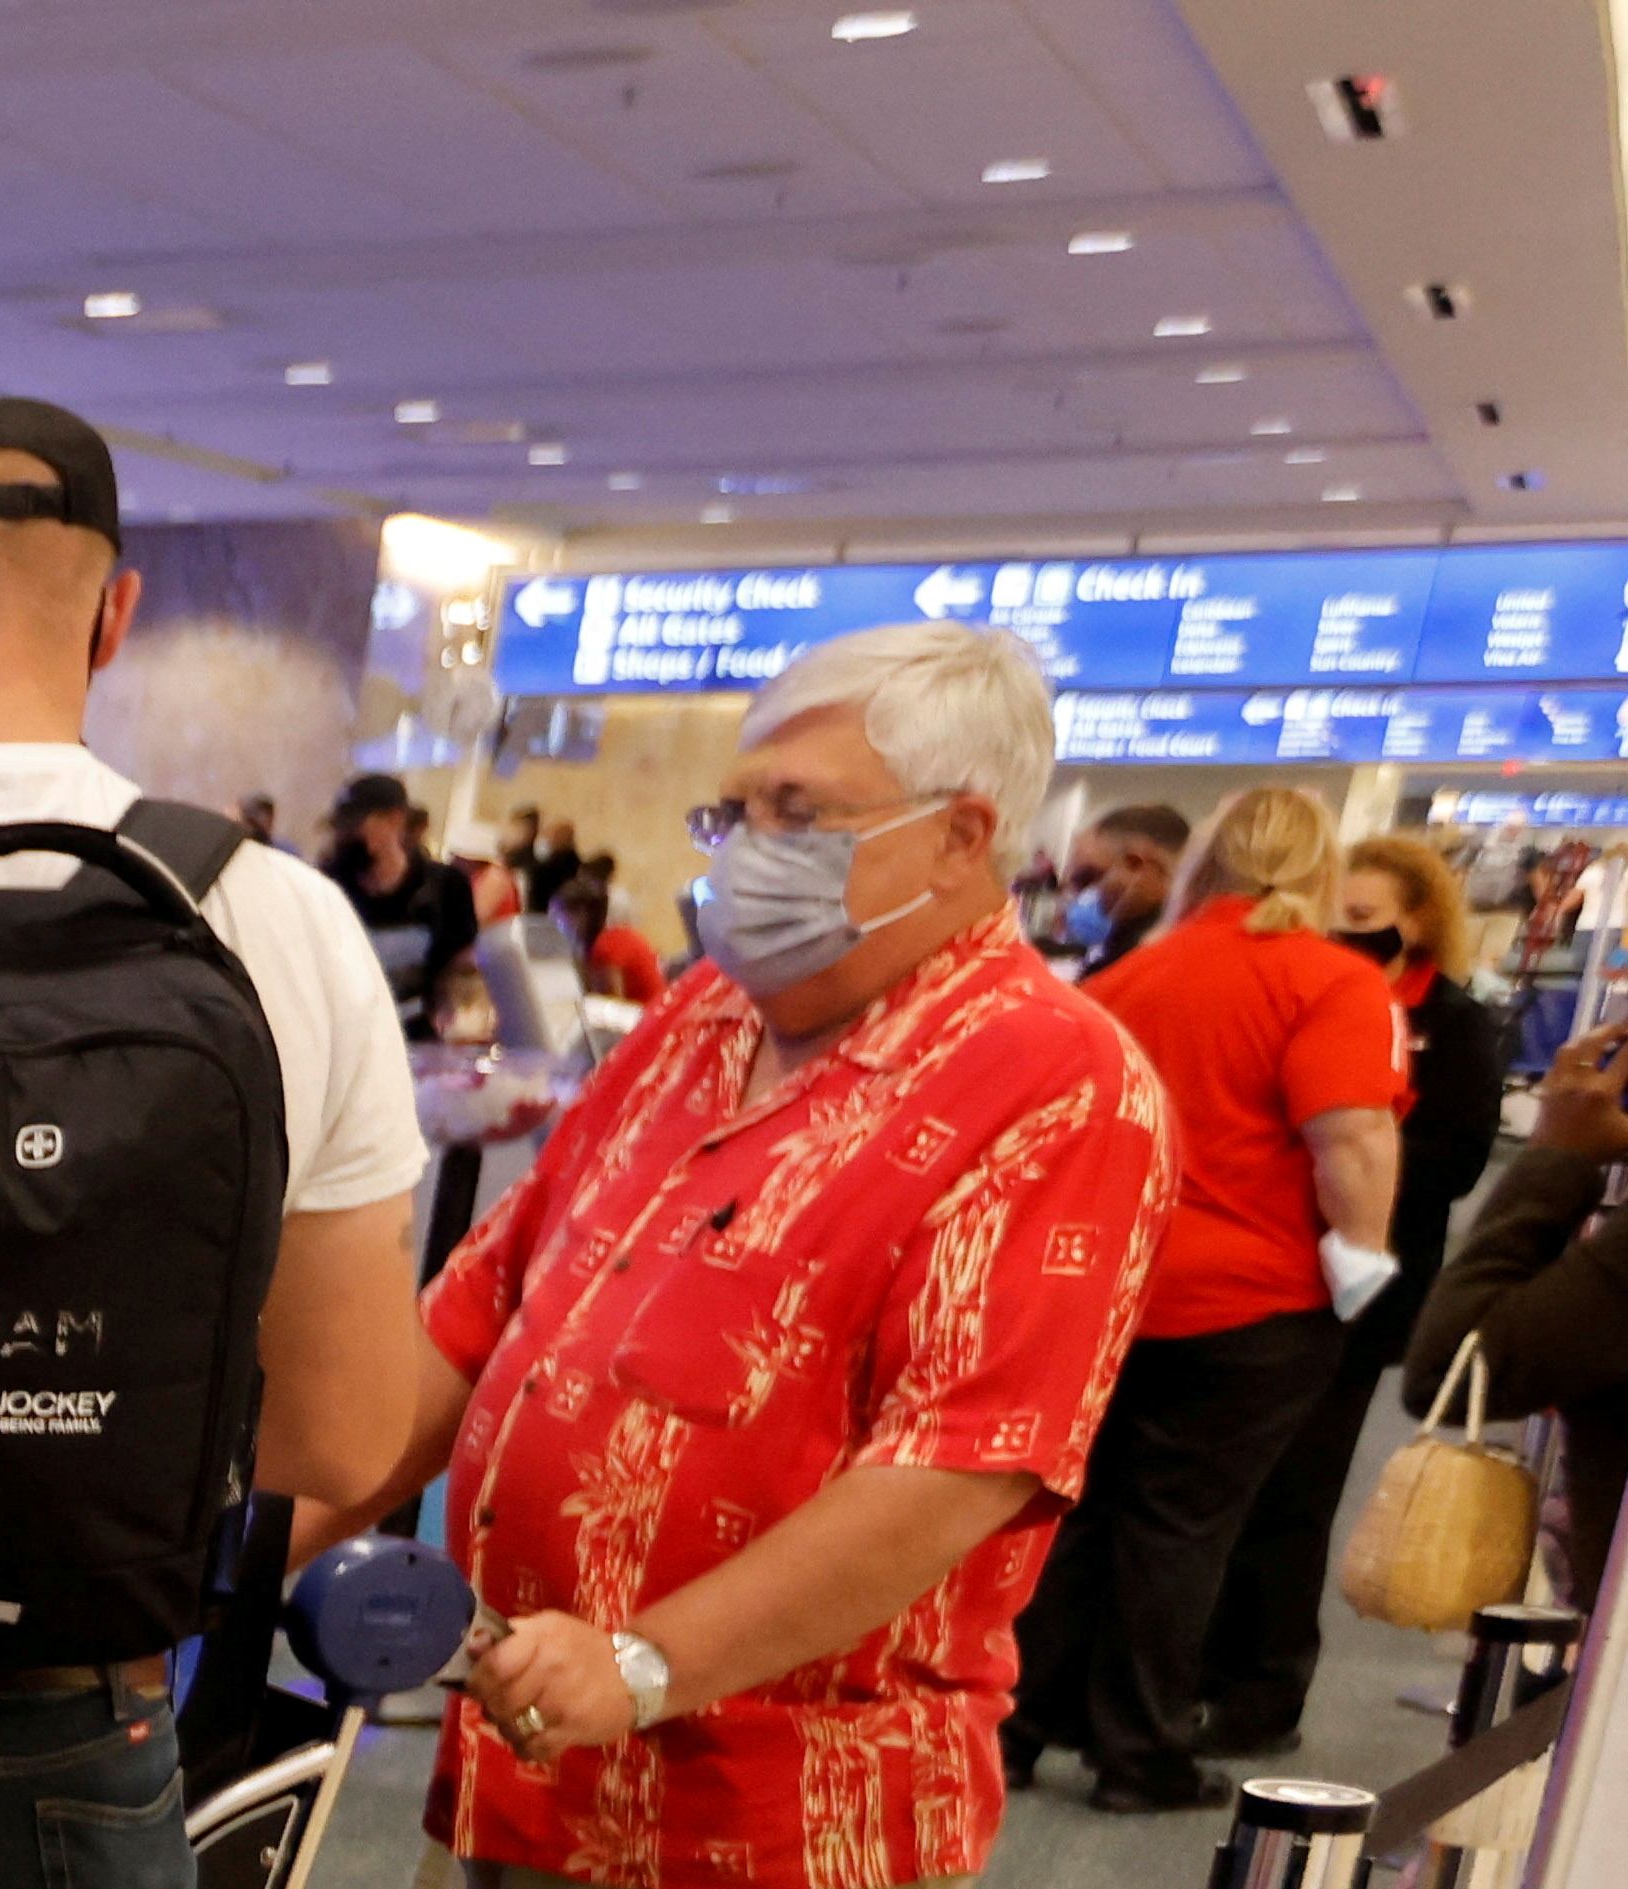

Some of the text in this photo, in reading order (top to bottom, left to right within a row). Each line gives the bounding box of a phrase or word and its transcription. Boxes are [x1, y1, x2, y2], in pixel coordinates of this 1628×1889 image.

[623, 571, 821, 616] Security Check
[1077, 562, 1208, 602] Check In
[618, 611, 746, 647] All Gates
[612, 646, 696, 685] Shops
